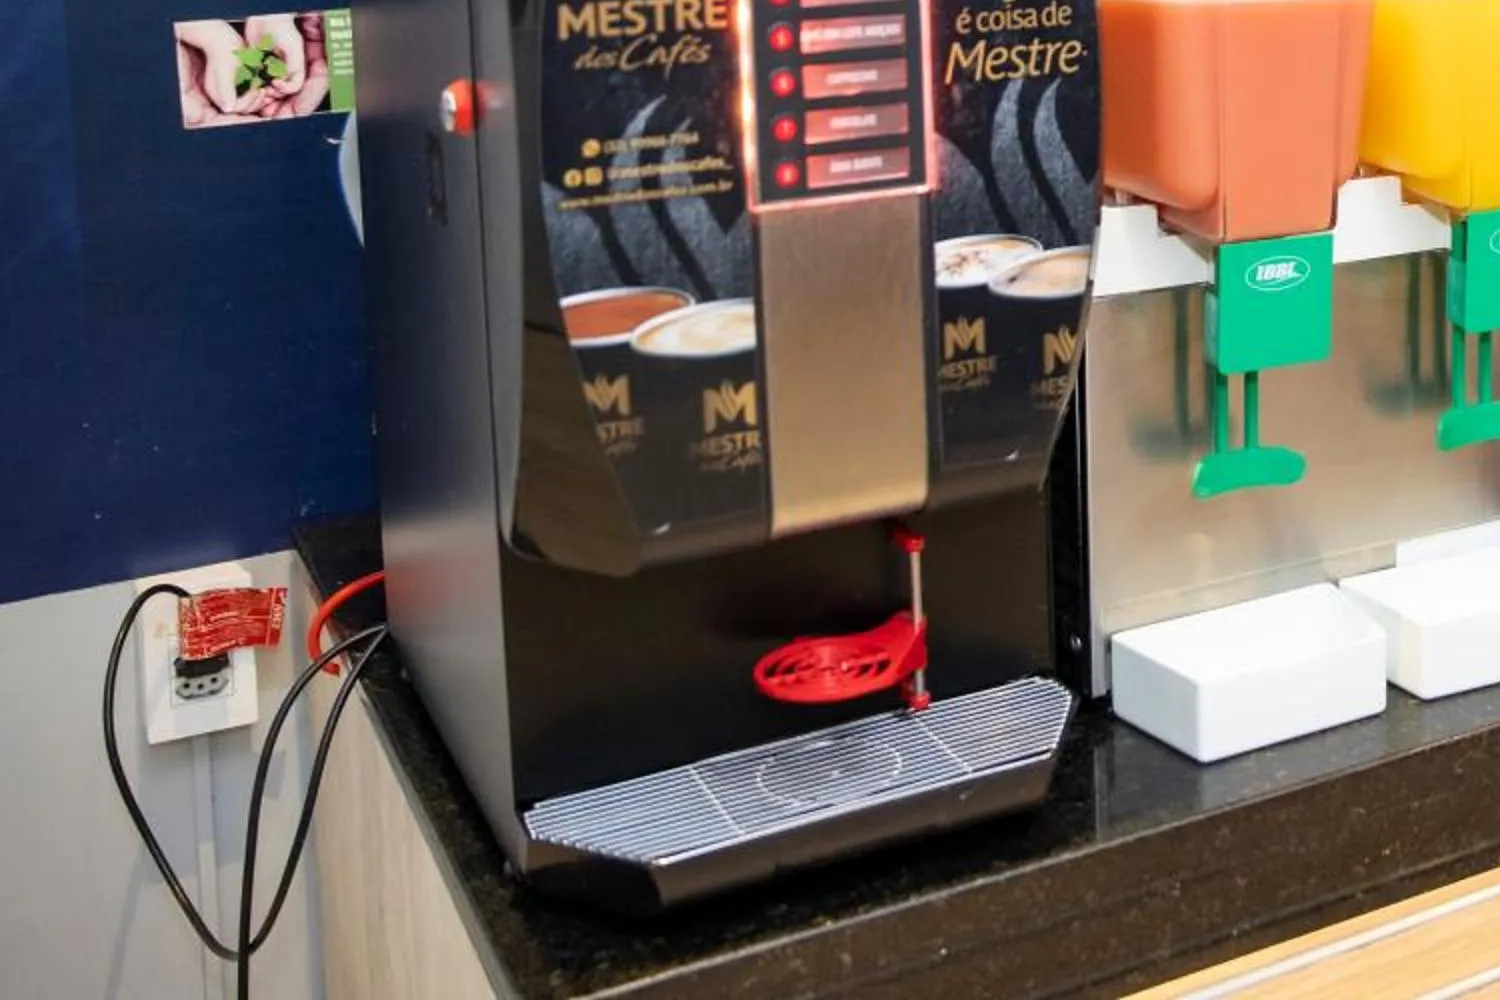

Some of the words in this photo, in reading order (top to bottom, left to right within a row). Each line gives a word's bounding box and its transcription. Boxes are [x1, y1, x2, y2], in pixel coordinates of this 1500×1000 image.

[955, 6, 972, 34] é
[976, 3, 1038, 32] coisa
[1041, 0, 1073, 26] de
[944, 37, 1083, 85] Mestre
[596, 416, 645, 443] STRE
[690, 429, 762, 456] MESTR
